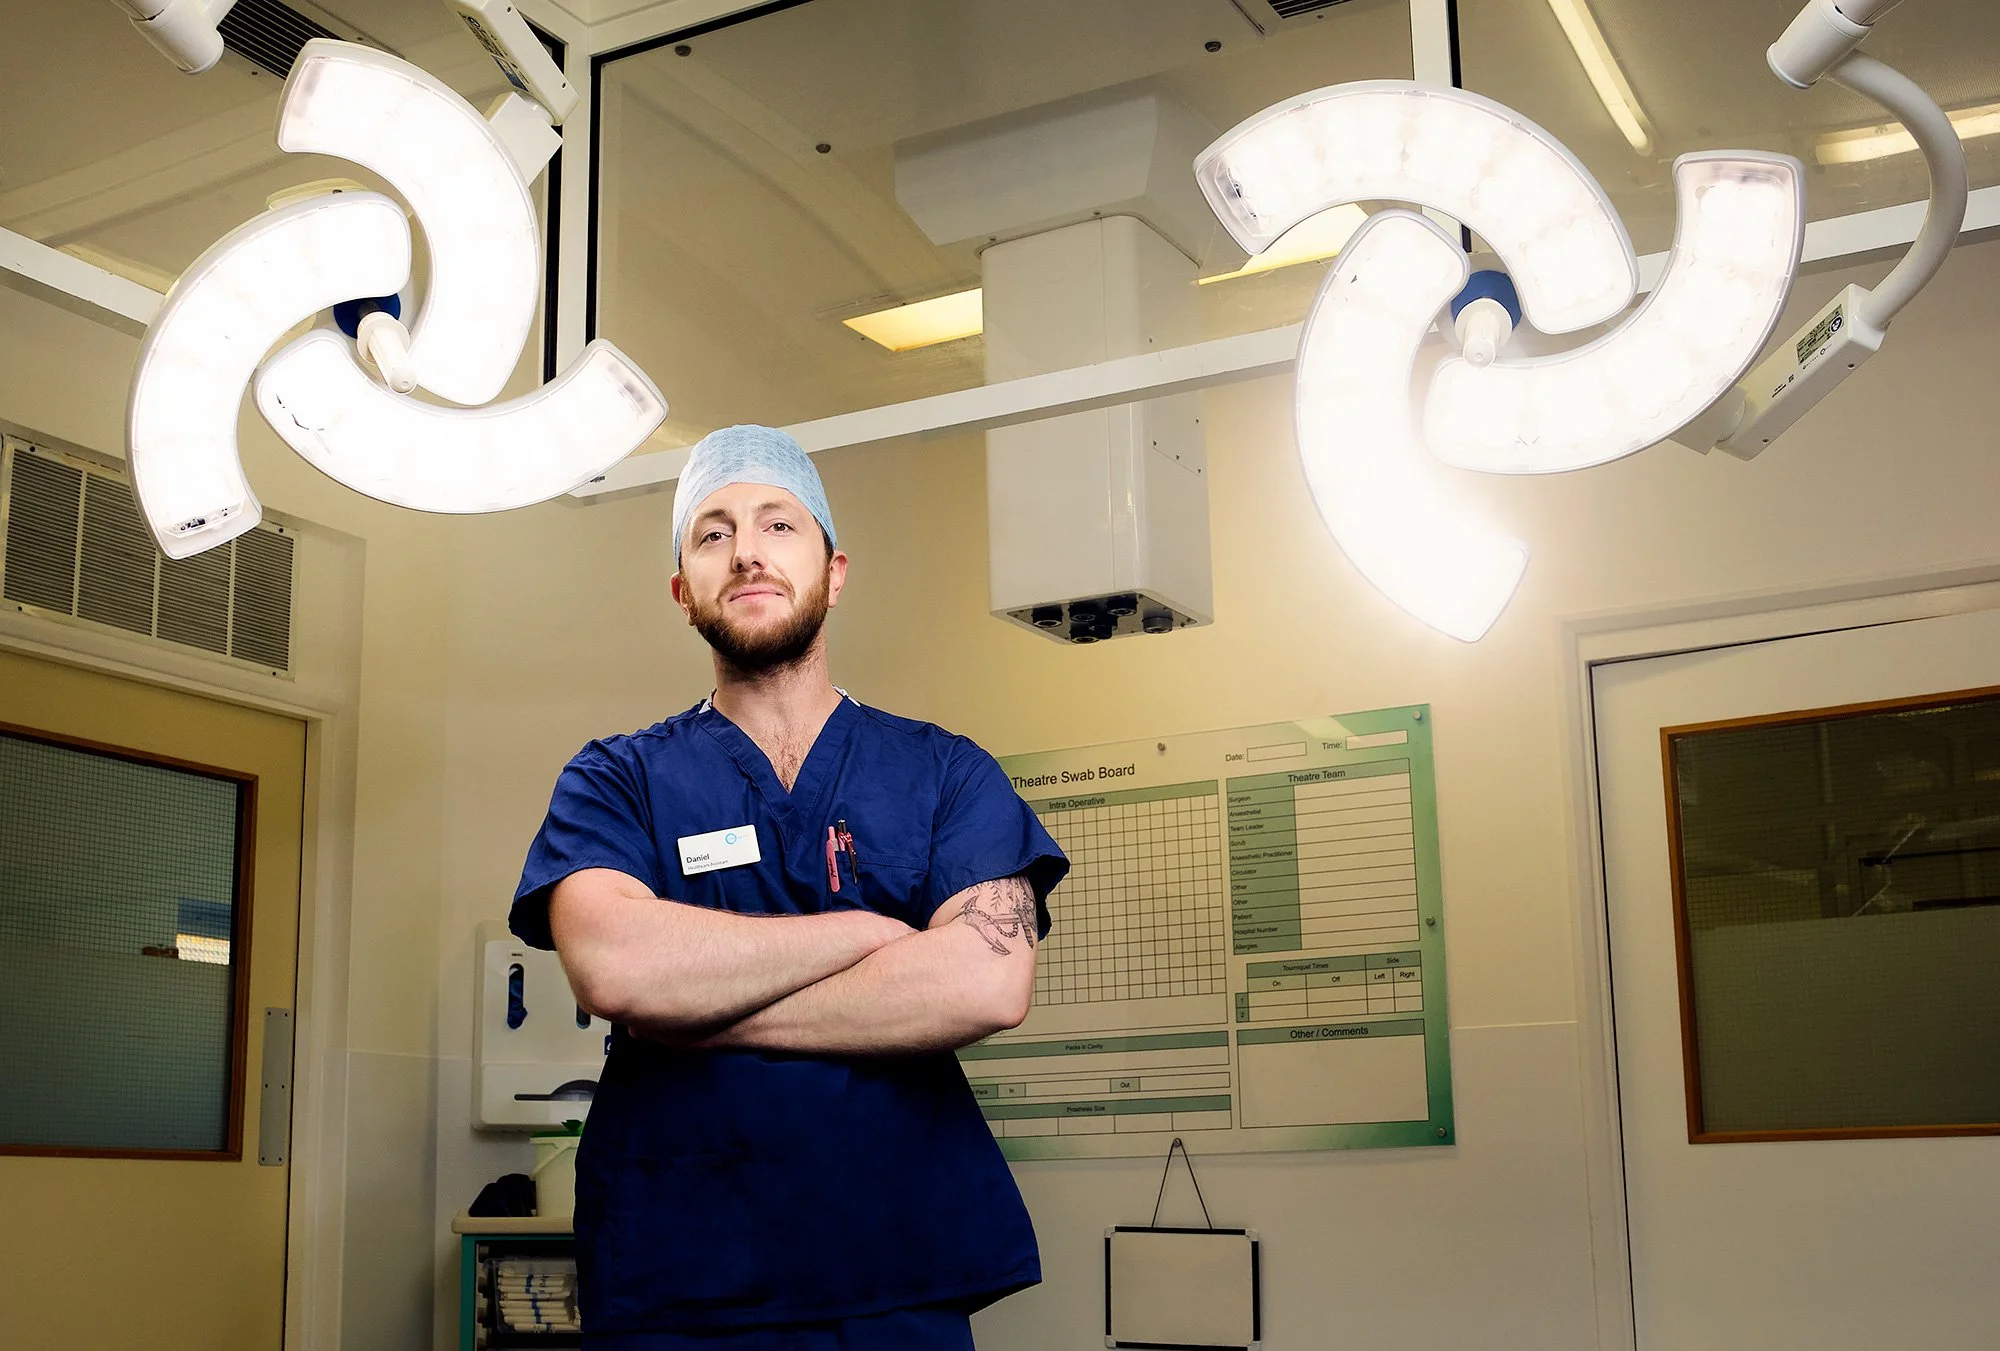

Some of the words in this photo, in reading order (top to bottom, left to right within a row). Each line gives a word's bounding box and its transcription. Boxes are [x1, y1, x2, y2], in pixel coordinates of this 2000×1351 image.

[1322, 741, 1342, 750] Time:
[1225, 753, 1245, 762] Date:
[1012, 775, 1057, 789] Theatre
[1061, 770, 1094, 784] Swab
[1098, 764, 1135, 779] Board
[1288, 772, 1320, 783] Theatre
[1322, 769, 1346, 780] Team
[1048, 800, 1066, 810] Intra
[1067, 796, 1106, 809] Operative
[1228, 795, 1251, 804] Surgeon
[1230, 824, 1244, 832] Team
[1245, 823, 1264, 831] Leader
[686, 853, 709, 863] Daniel
[1312, 962, 1329, 970] Times
[1399, 970, 1415, 979] Right
[1290, 1027, 1315, 1039] Other
[1321, 1026, 1369, 1037] Comments
